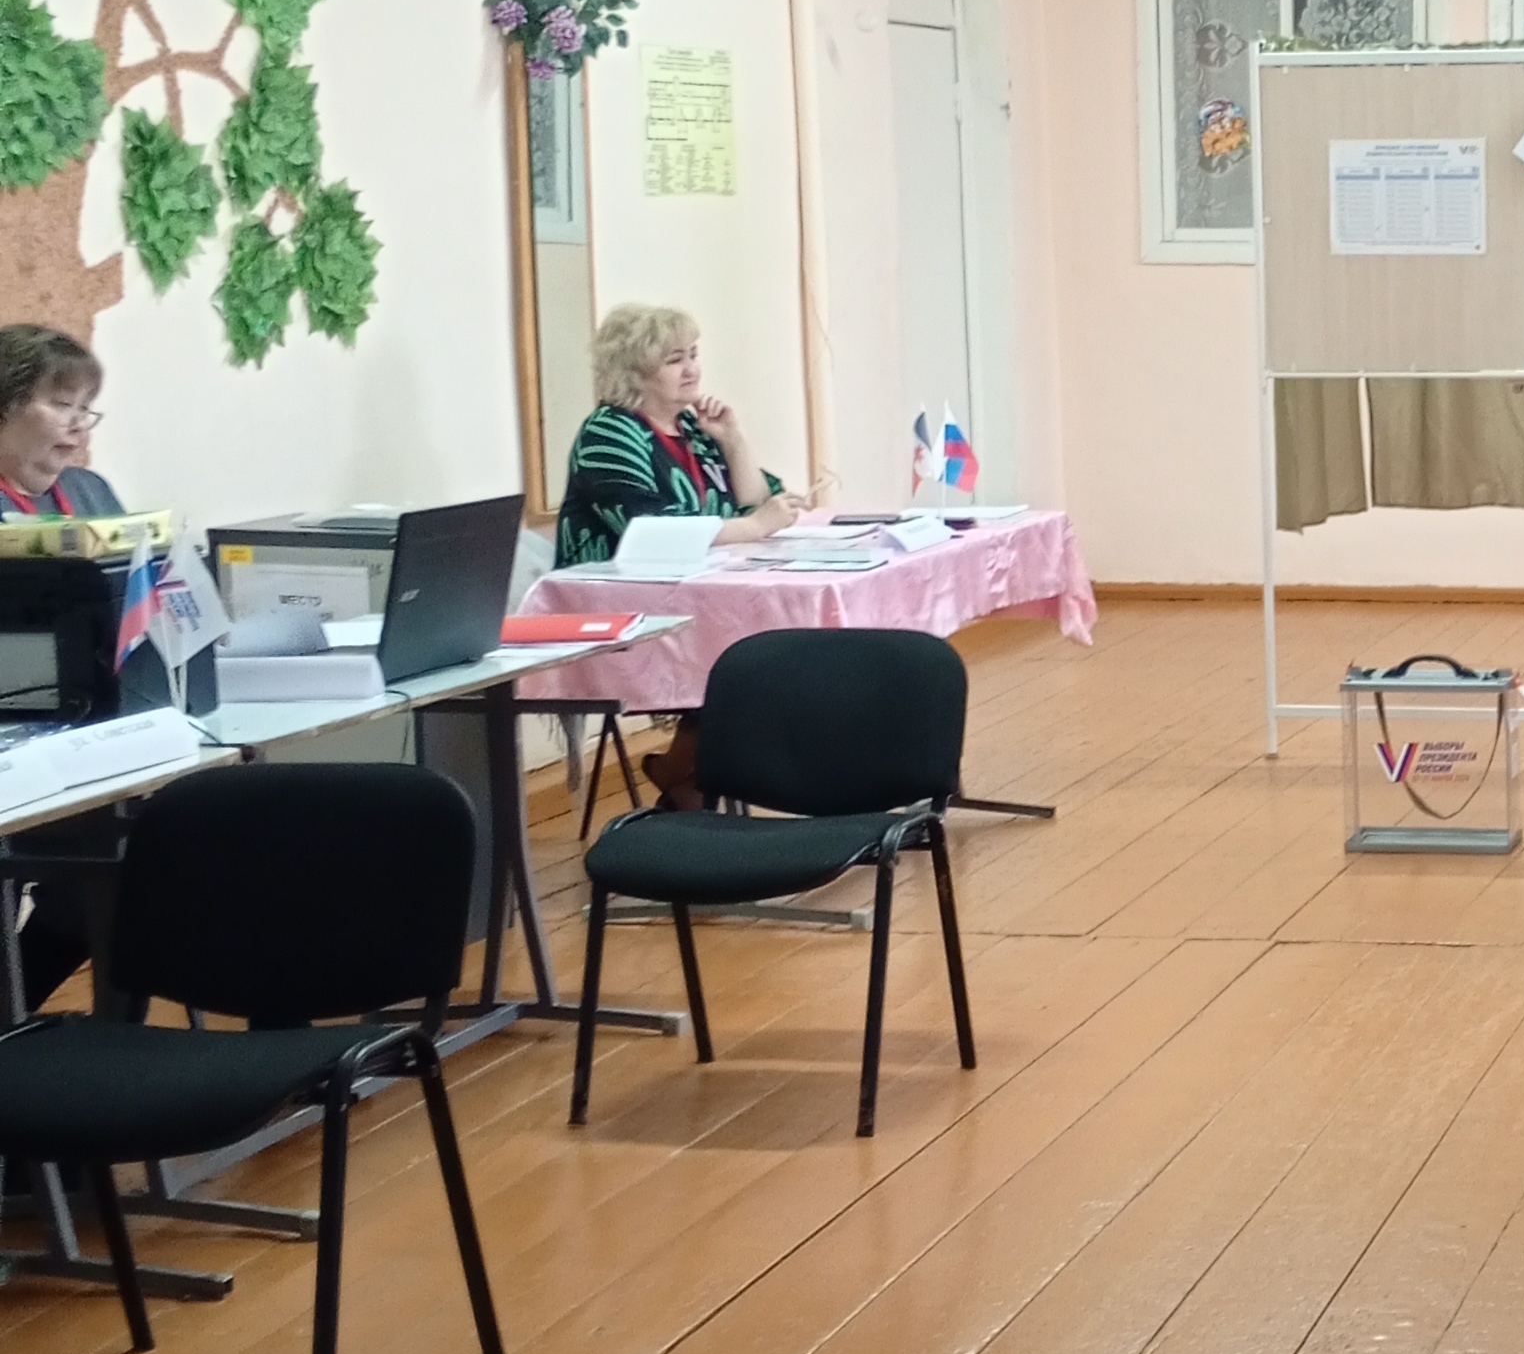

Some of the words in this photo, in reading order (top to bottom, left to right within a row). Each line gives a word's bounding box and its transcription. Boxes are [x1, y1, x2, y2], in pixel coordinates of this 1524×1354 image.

[1423, 741, 1466, 751] ВЫБОРЫ
[1418, 752, 1478, 762] ПРЕЗИДЕНТА
[1415, 764, 1453, 773] РОССИИ
